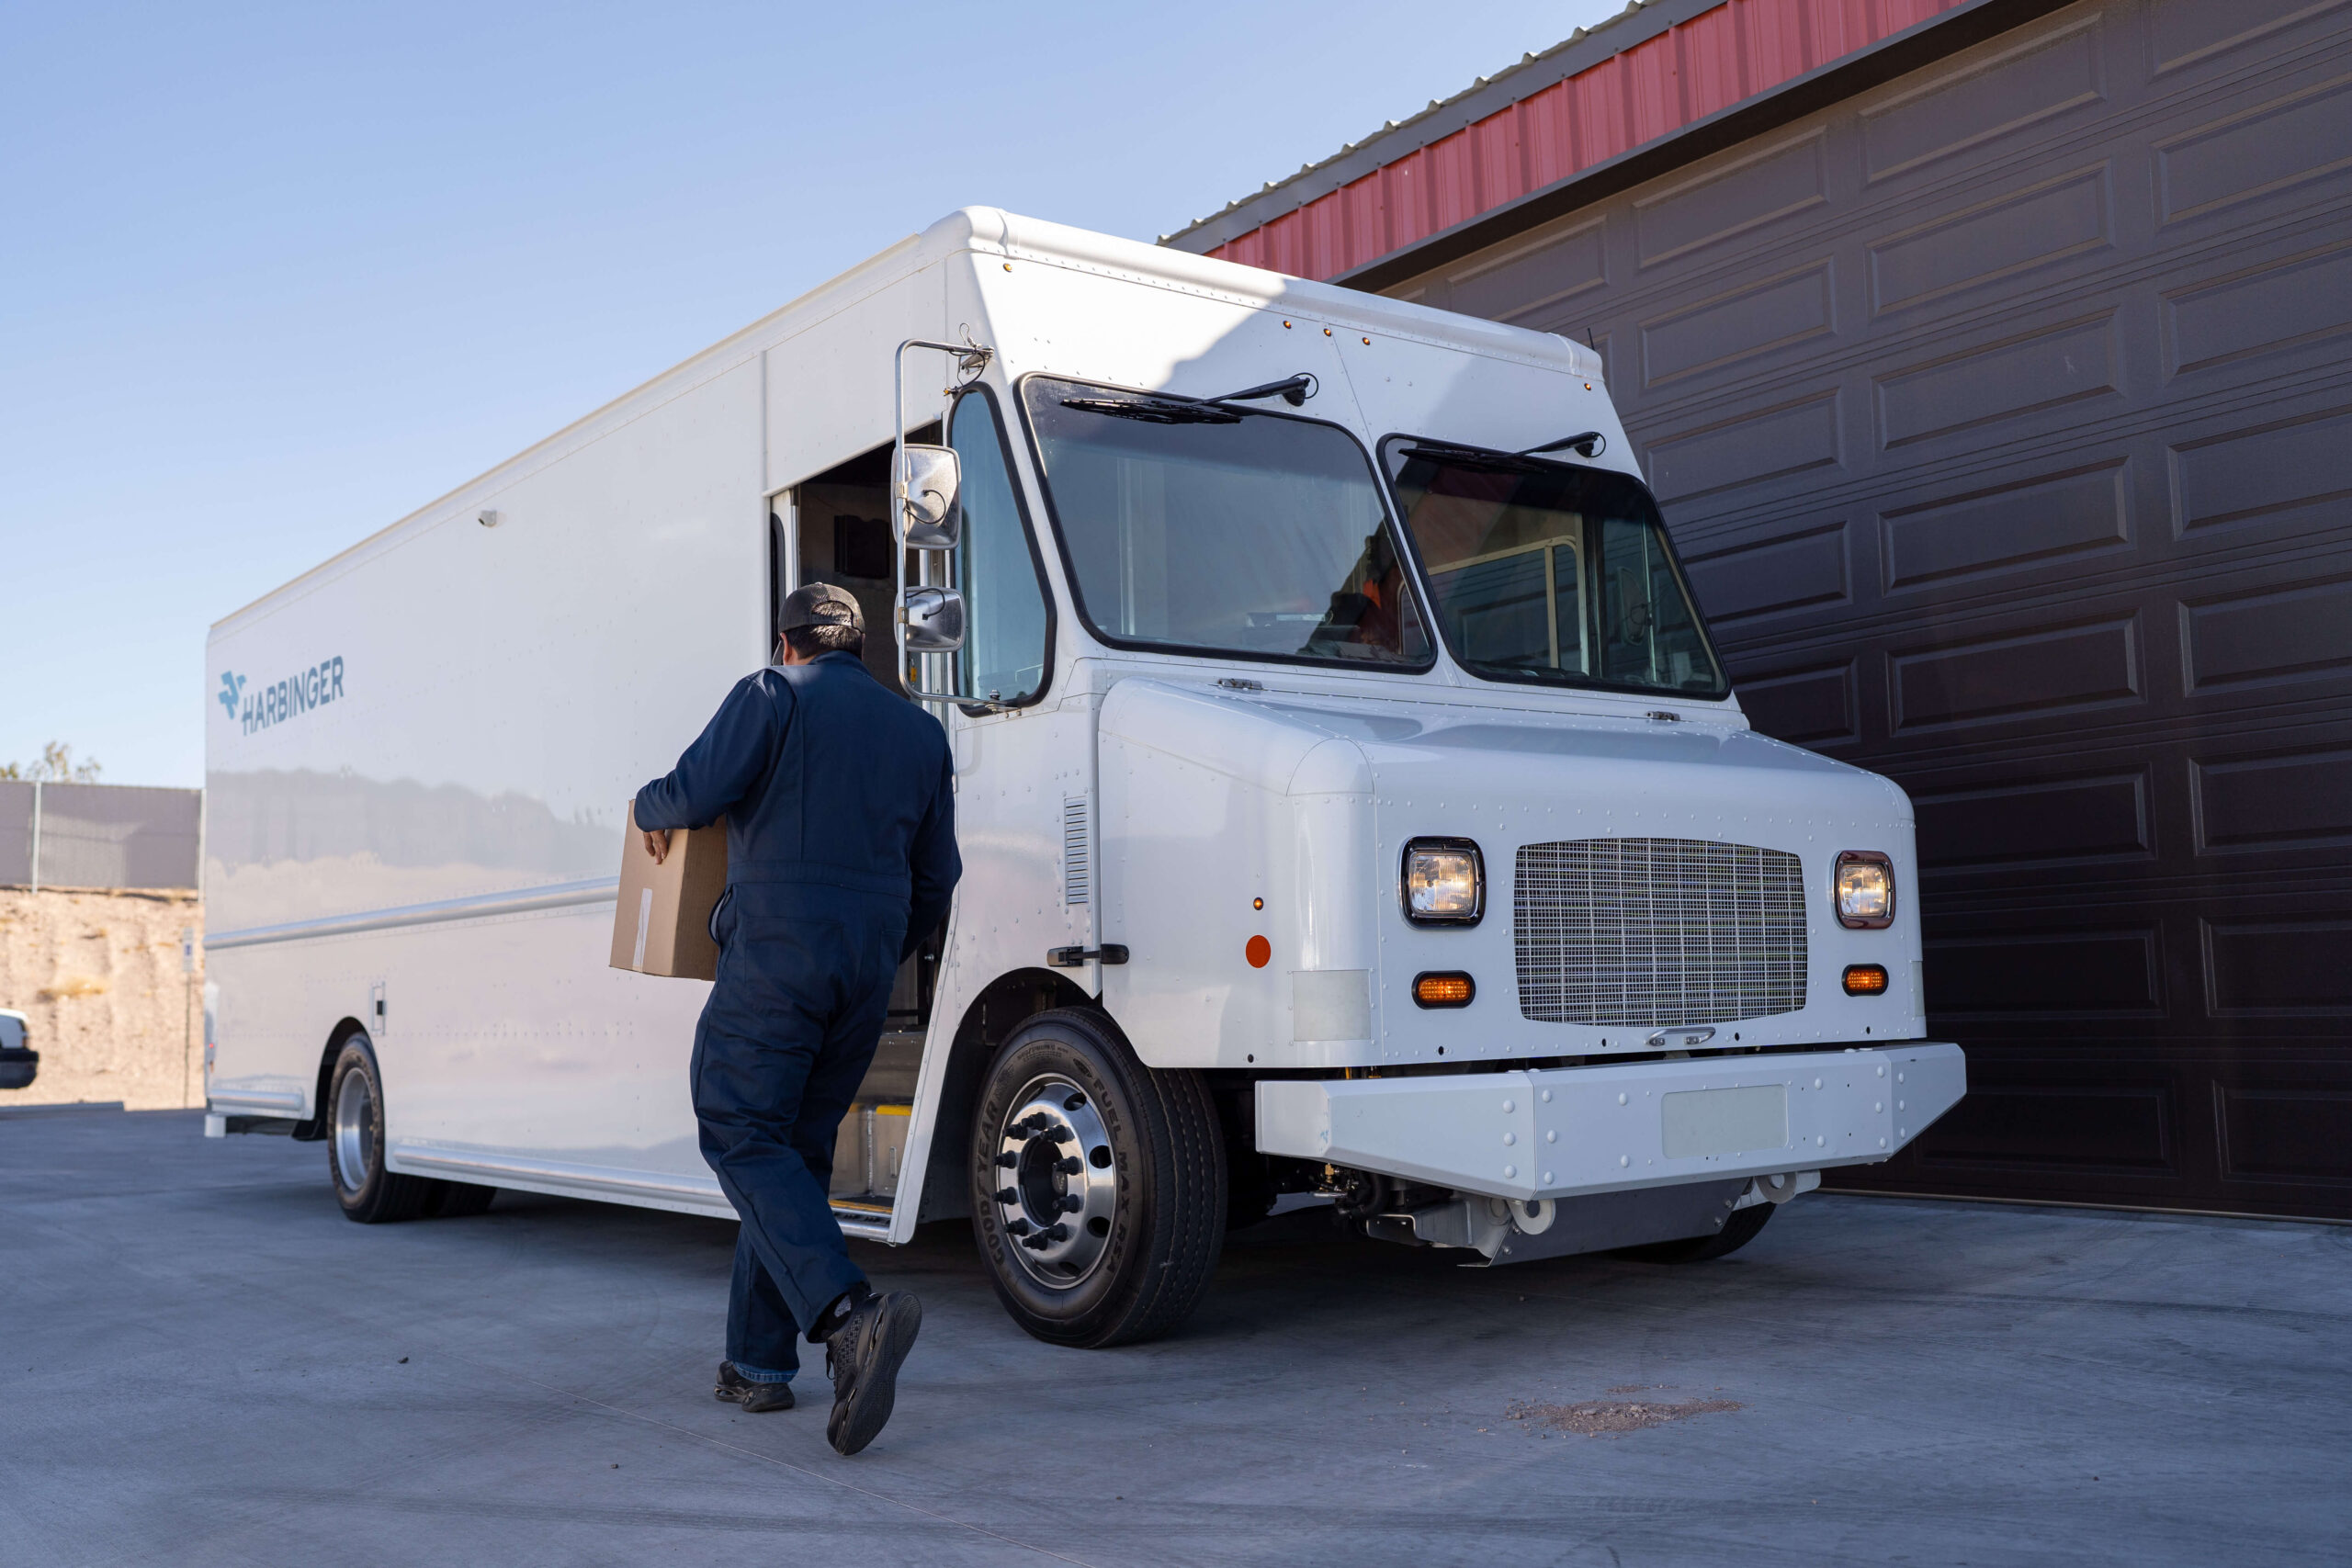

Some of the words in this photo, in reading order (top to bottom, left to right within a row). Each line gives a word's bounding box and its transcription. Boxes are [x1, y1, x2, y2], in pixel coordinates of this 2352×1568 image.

[242, 655, 344, 736] HARBINGER
[1093, 1080, 1122, 1141] FUEL
[1118, 1152, 1130, 1215] MAX
